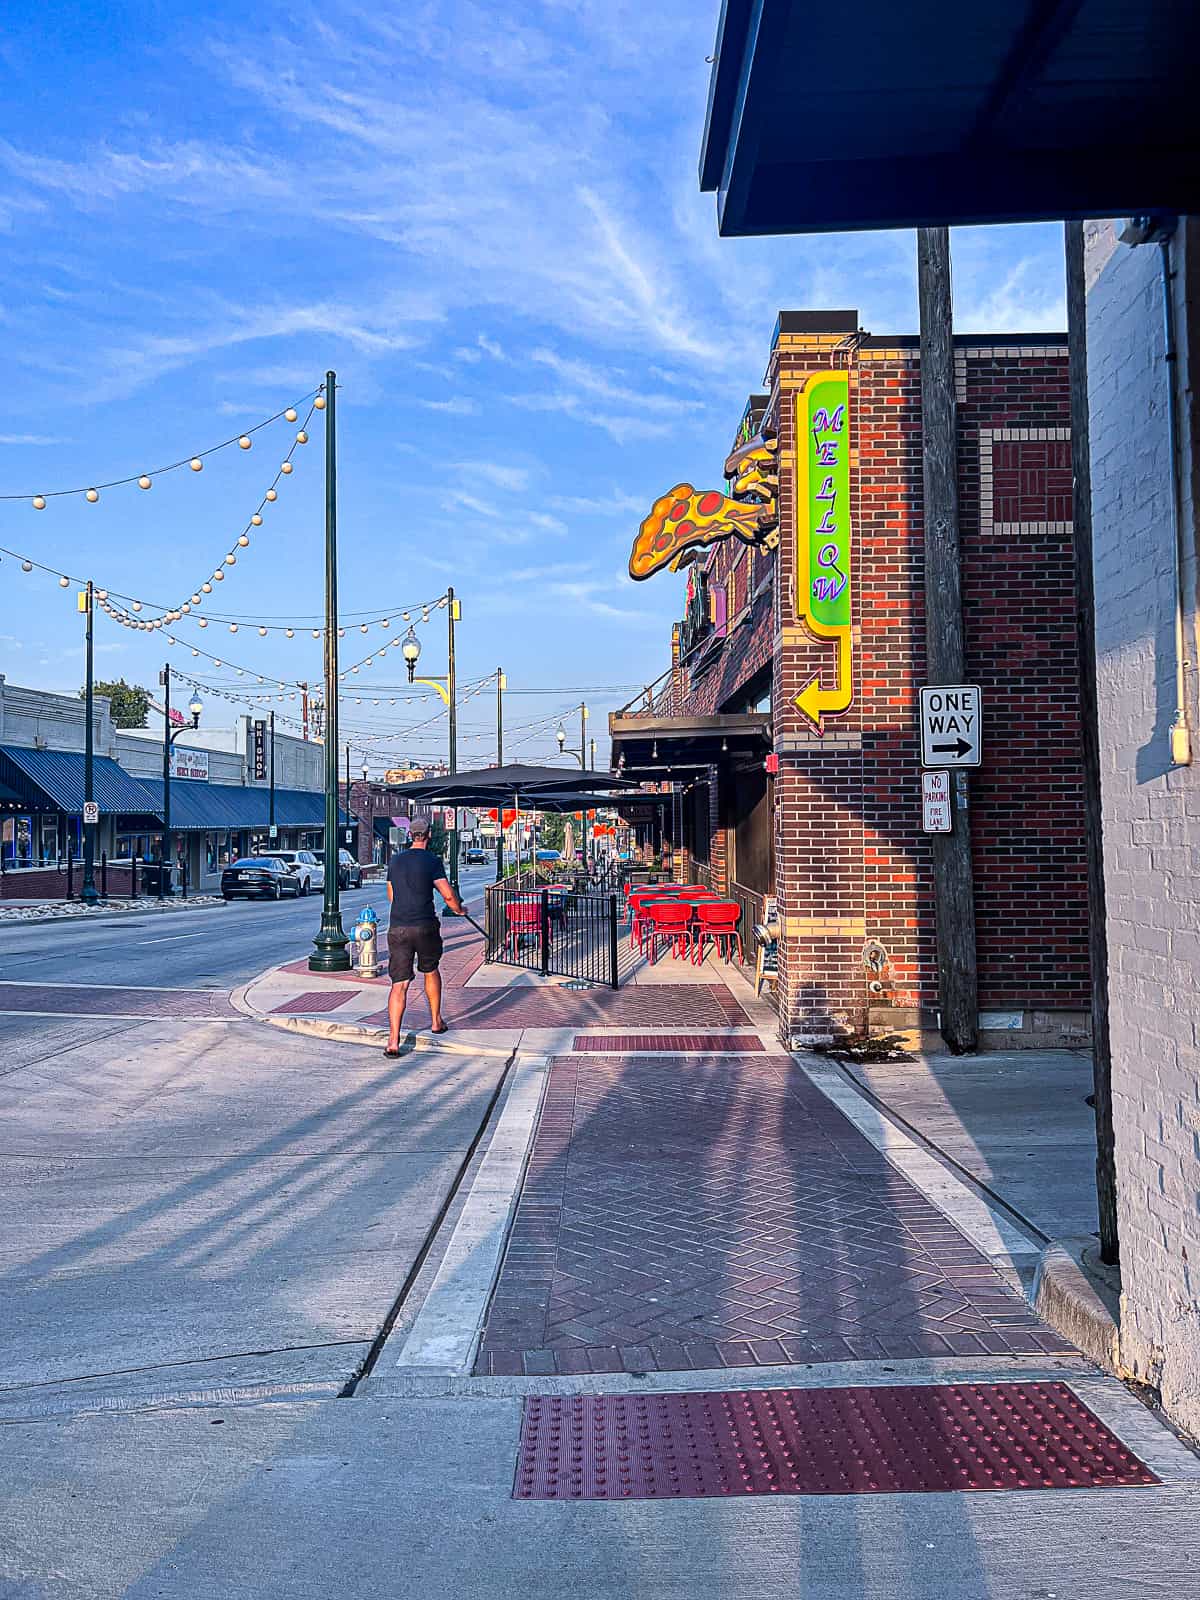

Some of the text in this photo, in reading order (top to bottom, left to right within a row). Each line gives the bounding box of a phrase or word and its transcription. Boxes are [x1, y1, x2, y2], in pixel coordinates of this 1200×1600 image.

[811, 404, 846, 601] MELLOW
[929, 693, 973, 712] ONE
[929, 715, 974, 734] WAY
[931, 777, 942, 789] NO
[924, 791, 947, 802] PARKING
[930, 808, 943, 816] FIRE
[929, 818, 944, 826] LANE
